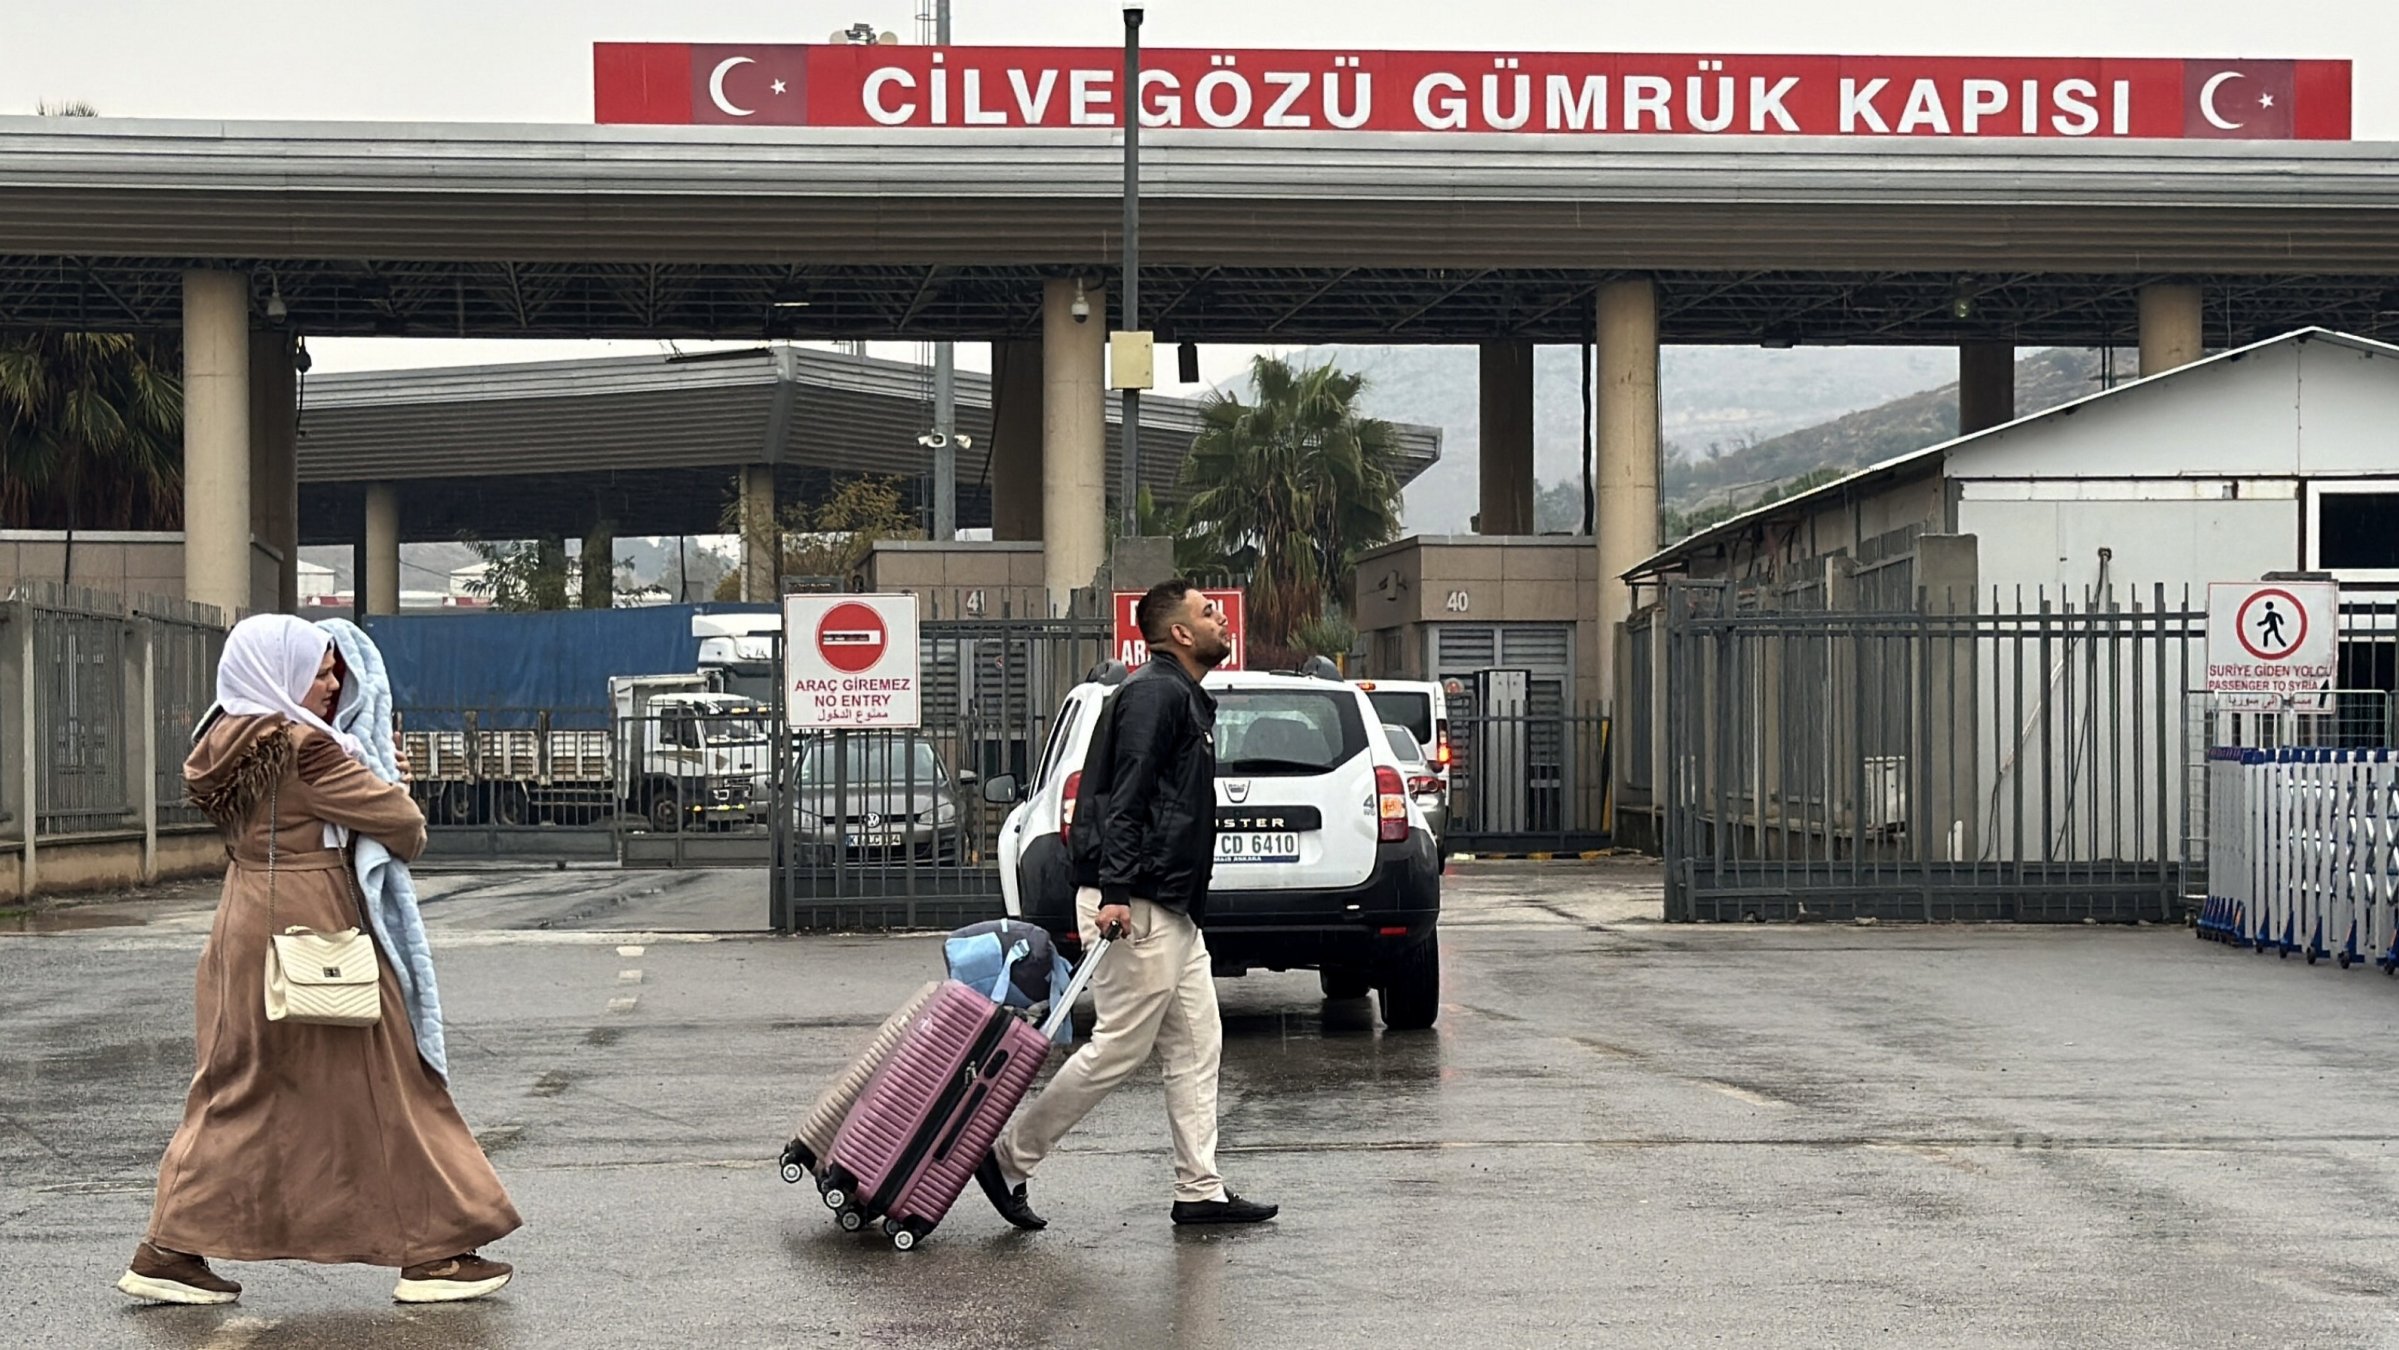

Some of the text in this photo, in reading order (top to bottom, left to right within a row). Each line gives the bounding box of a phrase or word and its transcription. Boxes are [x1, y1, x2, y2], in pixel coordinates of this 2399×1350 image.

[862, 52, 2129, 136] CİLVEGÖZÜ GÜMRÜK KAPISI
[1447, 591, 1469, 612] 40
[2209, 663, 2333, 678] SURİYE GİDEN YOLCU
[795, 676, 911, 694] ARAÇ GİREMEZ
[2208, 680, 2270, 691] PASSENGER
[2273, 680, 2287, 692] TO
[815, 694, 891, 708] NO ENTRY
[818, 707, 889, 724] ممنوع الدخول
[1221, 834, 1294, 854] CD 6410
